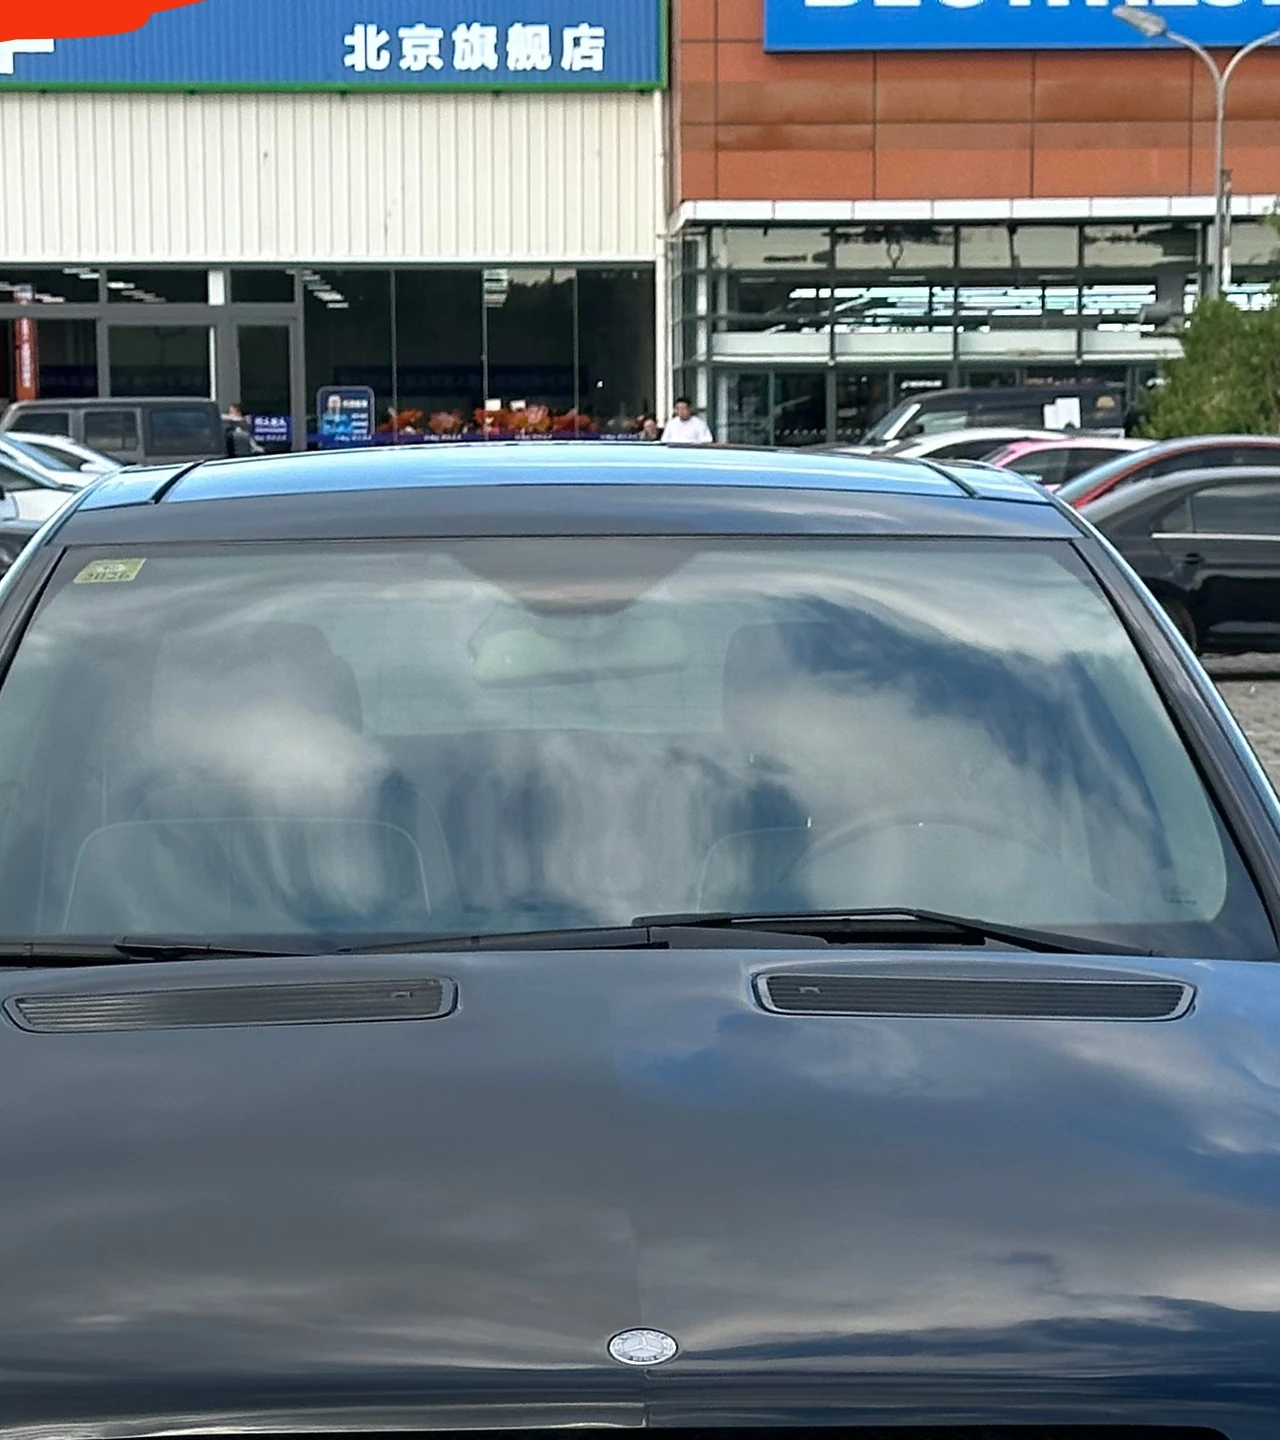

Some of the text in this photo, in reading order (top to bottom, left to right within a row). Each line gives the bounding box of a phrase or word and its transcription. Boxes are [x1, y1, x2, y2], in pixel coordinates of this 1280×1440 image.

[343, 21, 606, 72] 北京旗舰店
